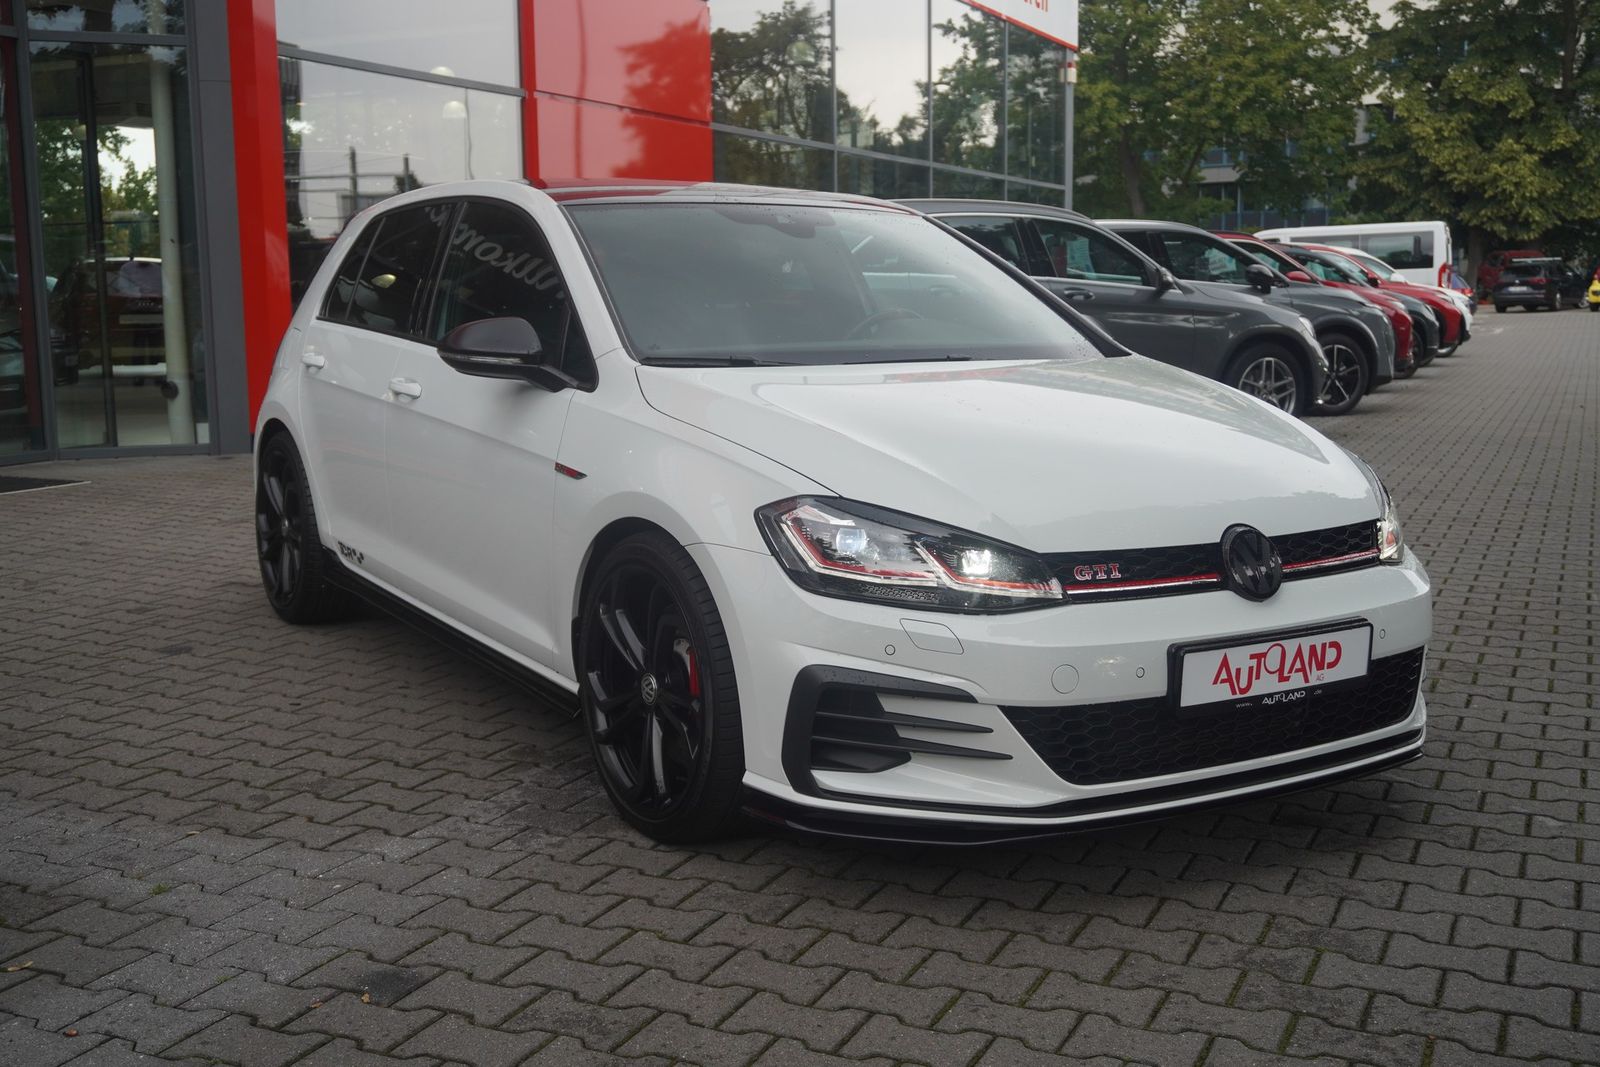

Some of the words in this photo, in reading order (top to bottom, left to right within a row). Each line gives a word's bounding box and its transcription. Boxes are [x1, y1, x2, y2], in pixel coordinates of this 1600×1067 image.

[1073, 563, 1122, 581] GTI
[1212, 640, 1343, 696] AUTOLAND
[1261, 690, 1306, 705] AUTOLAND
